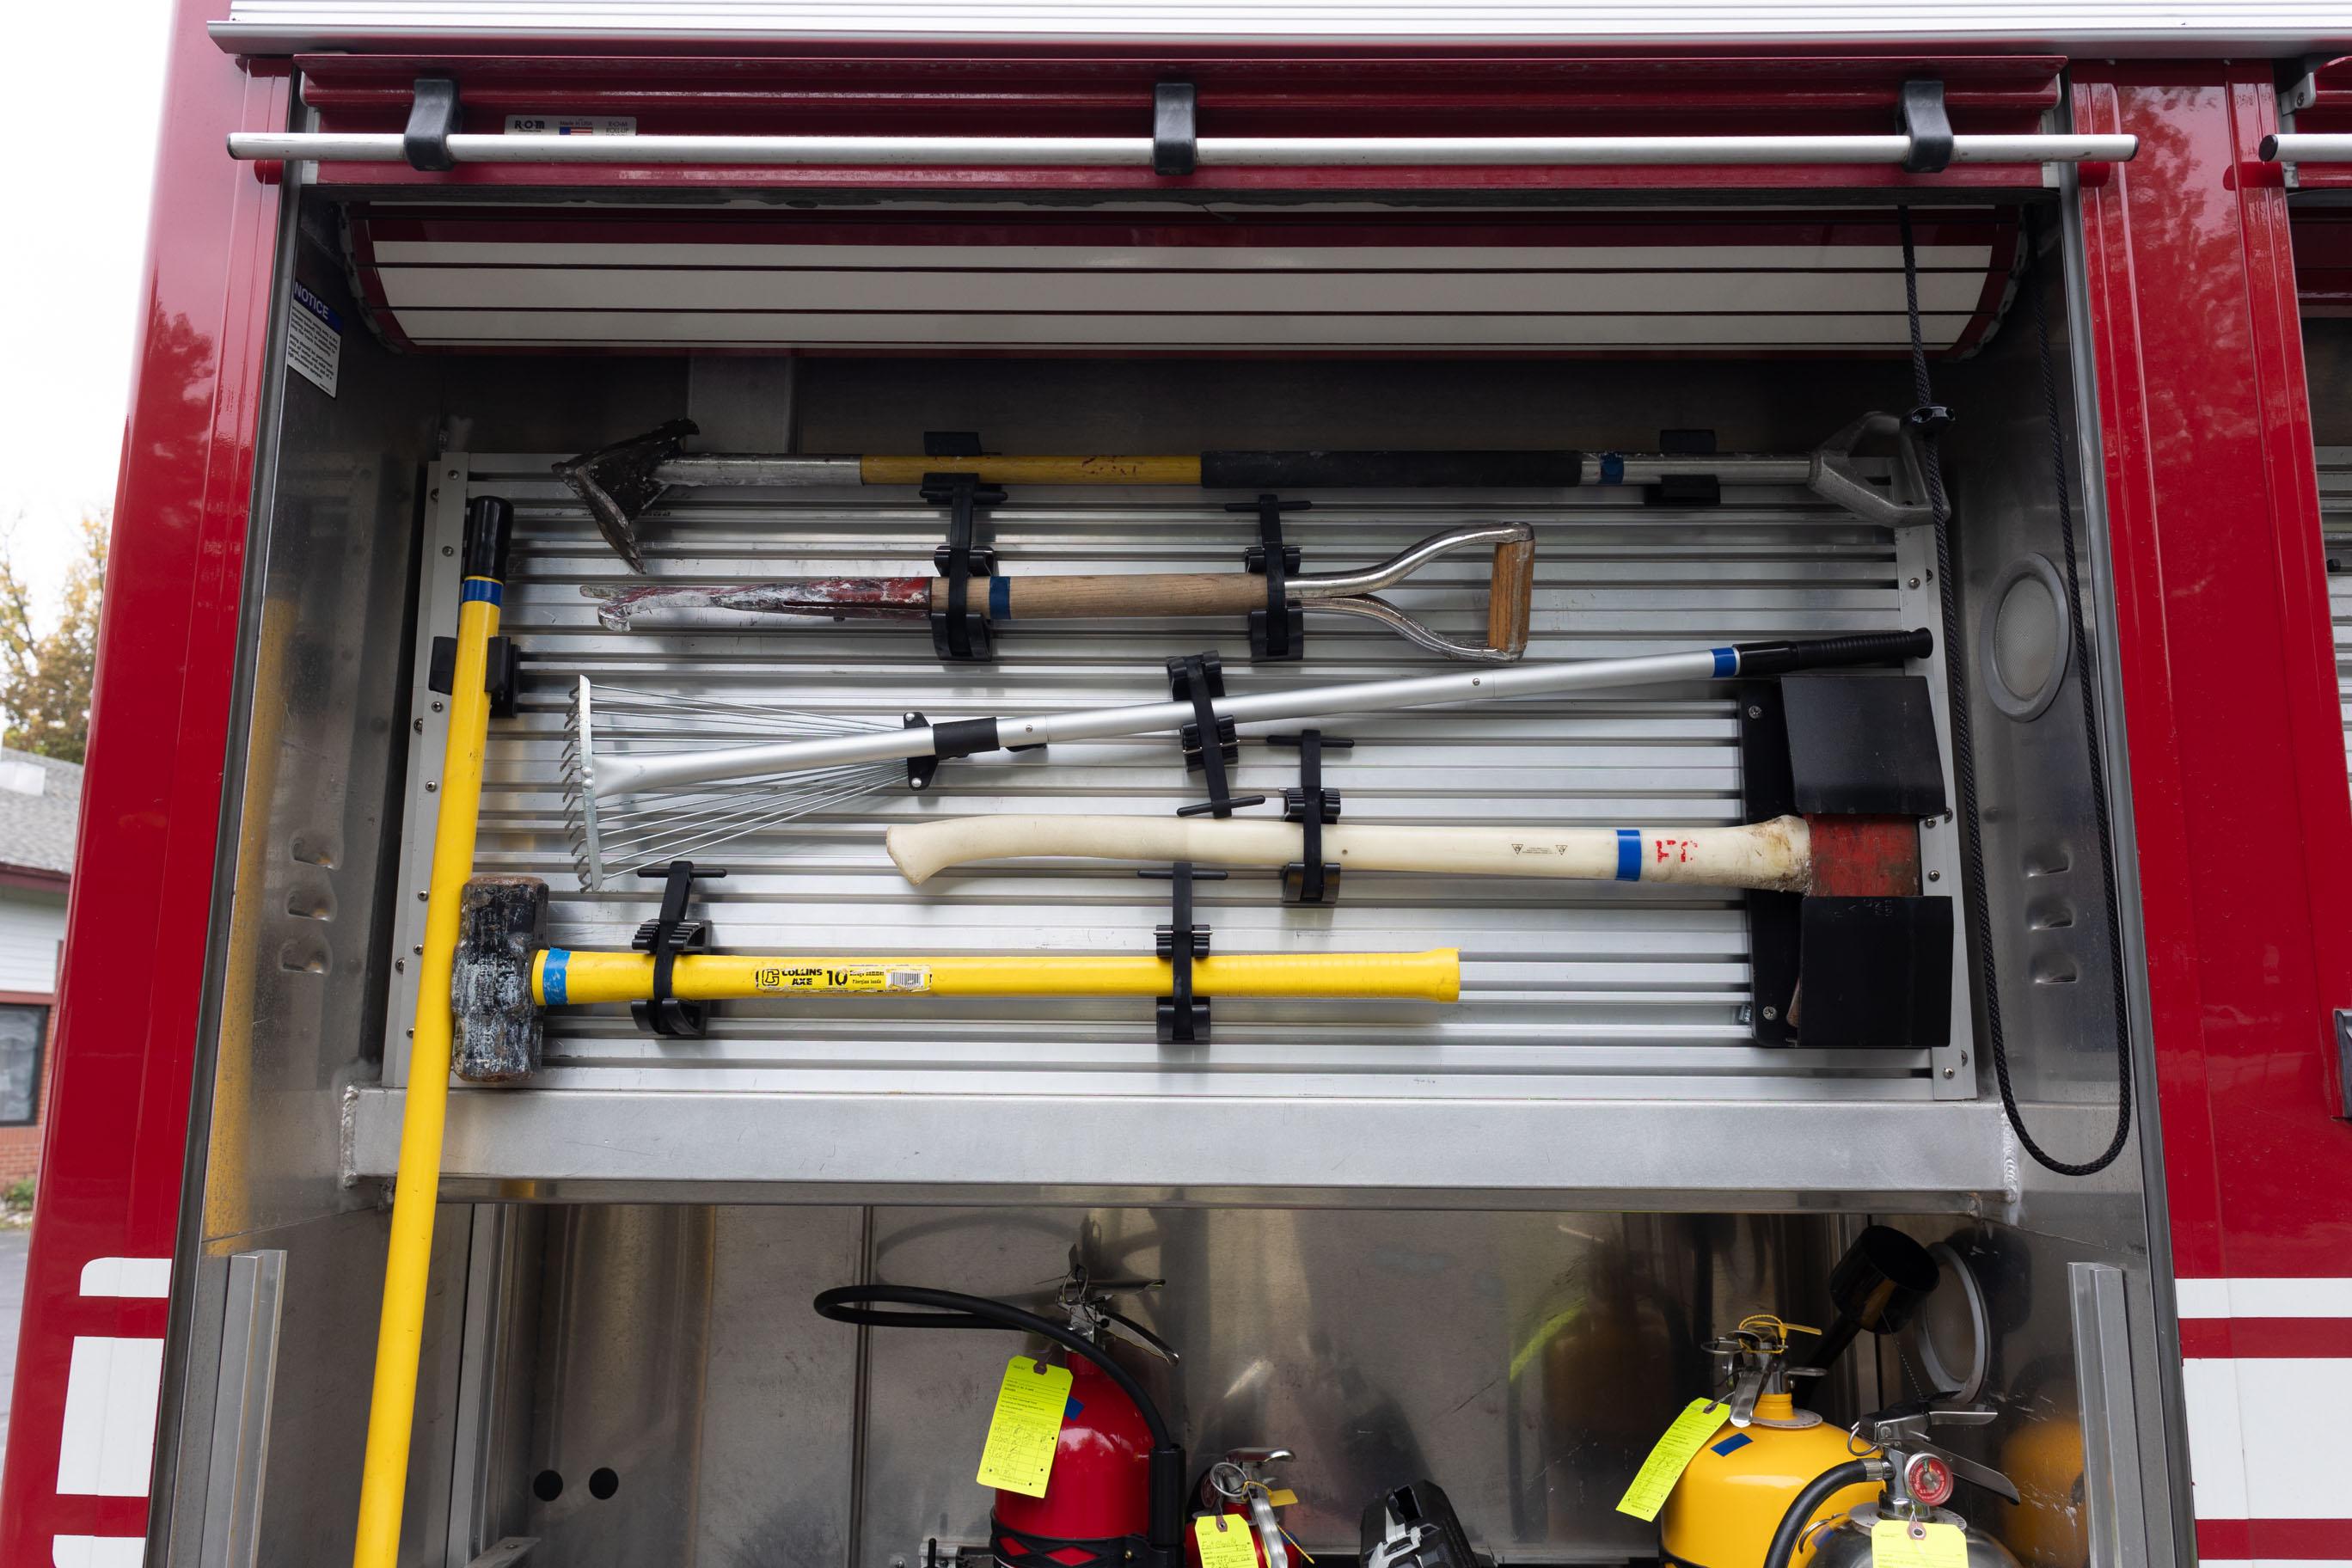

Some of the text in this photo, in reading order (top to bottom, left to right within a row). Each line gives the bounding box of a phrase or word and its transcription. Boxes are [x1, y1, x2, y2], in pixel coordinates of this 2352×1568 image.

[294, 281, 329, 320] NOTICE
[781, 968, 822, 977] COLLINS
[827, 969, 848, 986] 10
